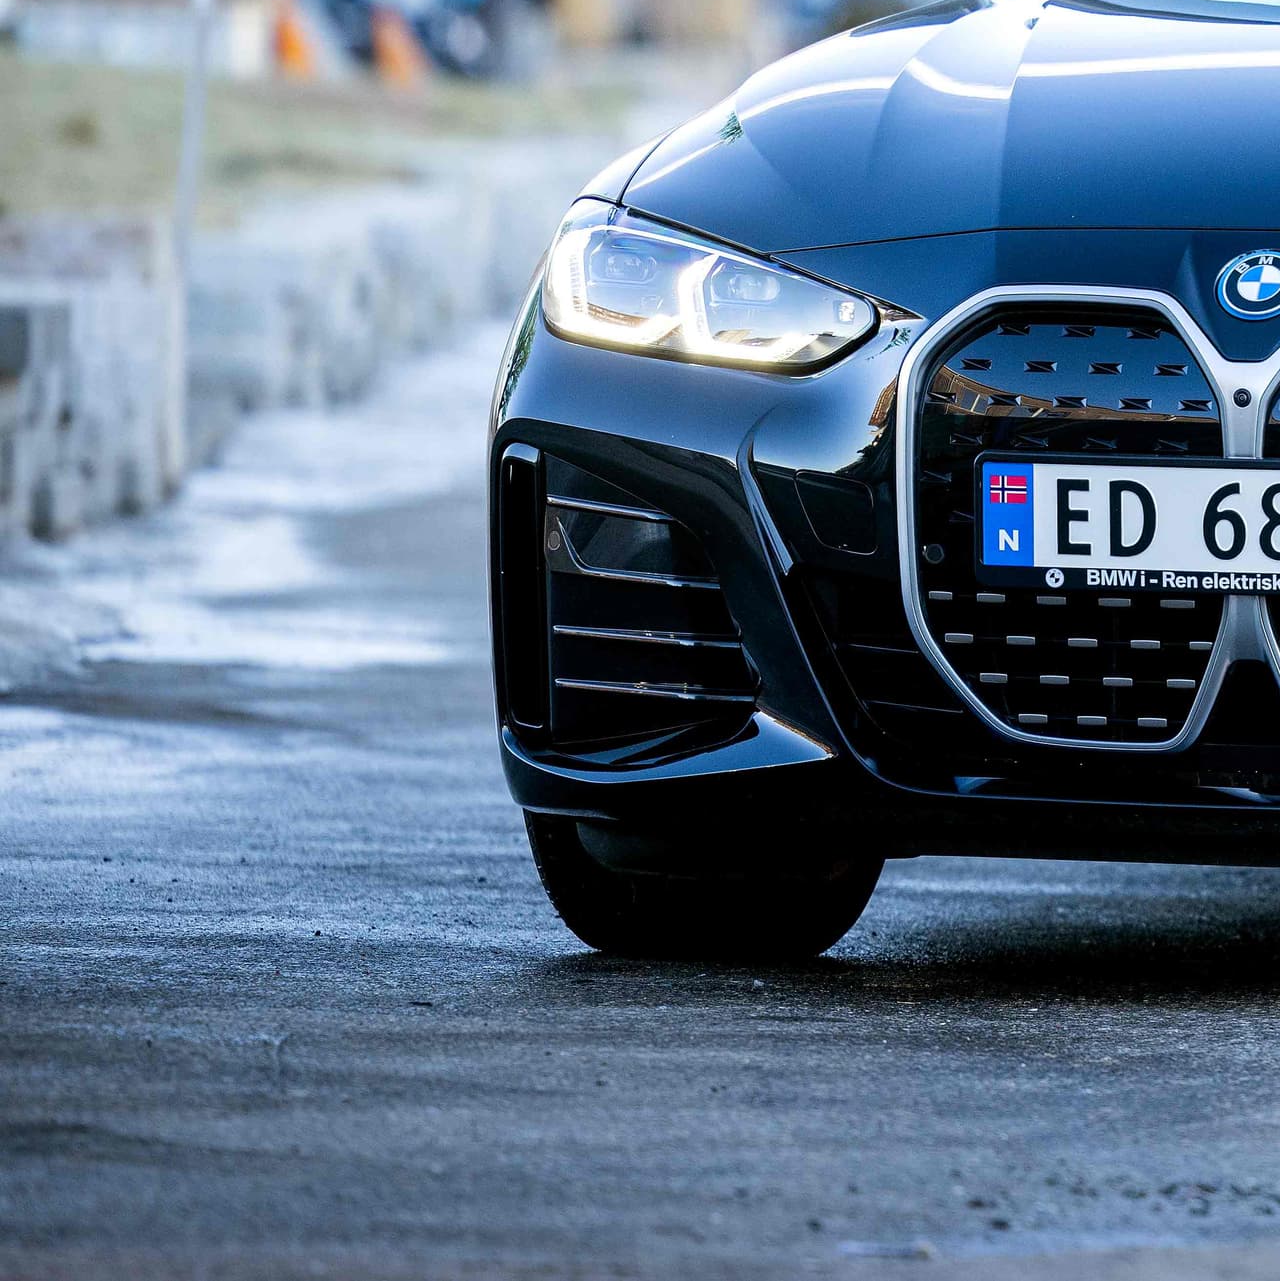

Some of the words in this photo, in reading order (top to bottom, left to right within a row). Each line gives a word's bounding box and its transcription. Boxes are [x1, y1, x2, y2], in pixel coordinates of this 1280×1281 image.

[1056, 478, 1157, 558] ED
[998, 529, 1019, 552] N
[1086, 569, 1137, 587] BMW
[1140, 570, 1147, 588] i
[1161, 571, 1199, 589] Ren
